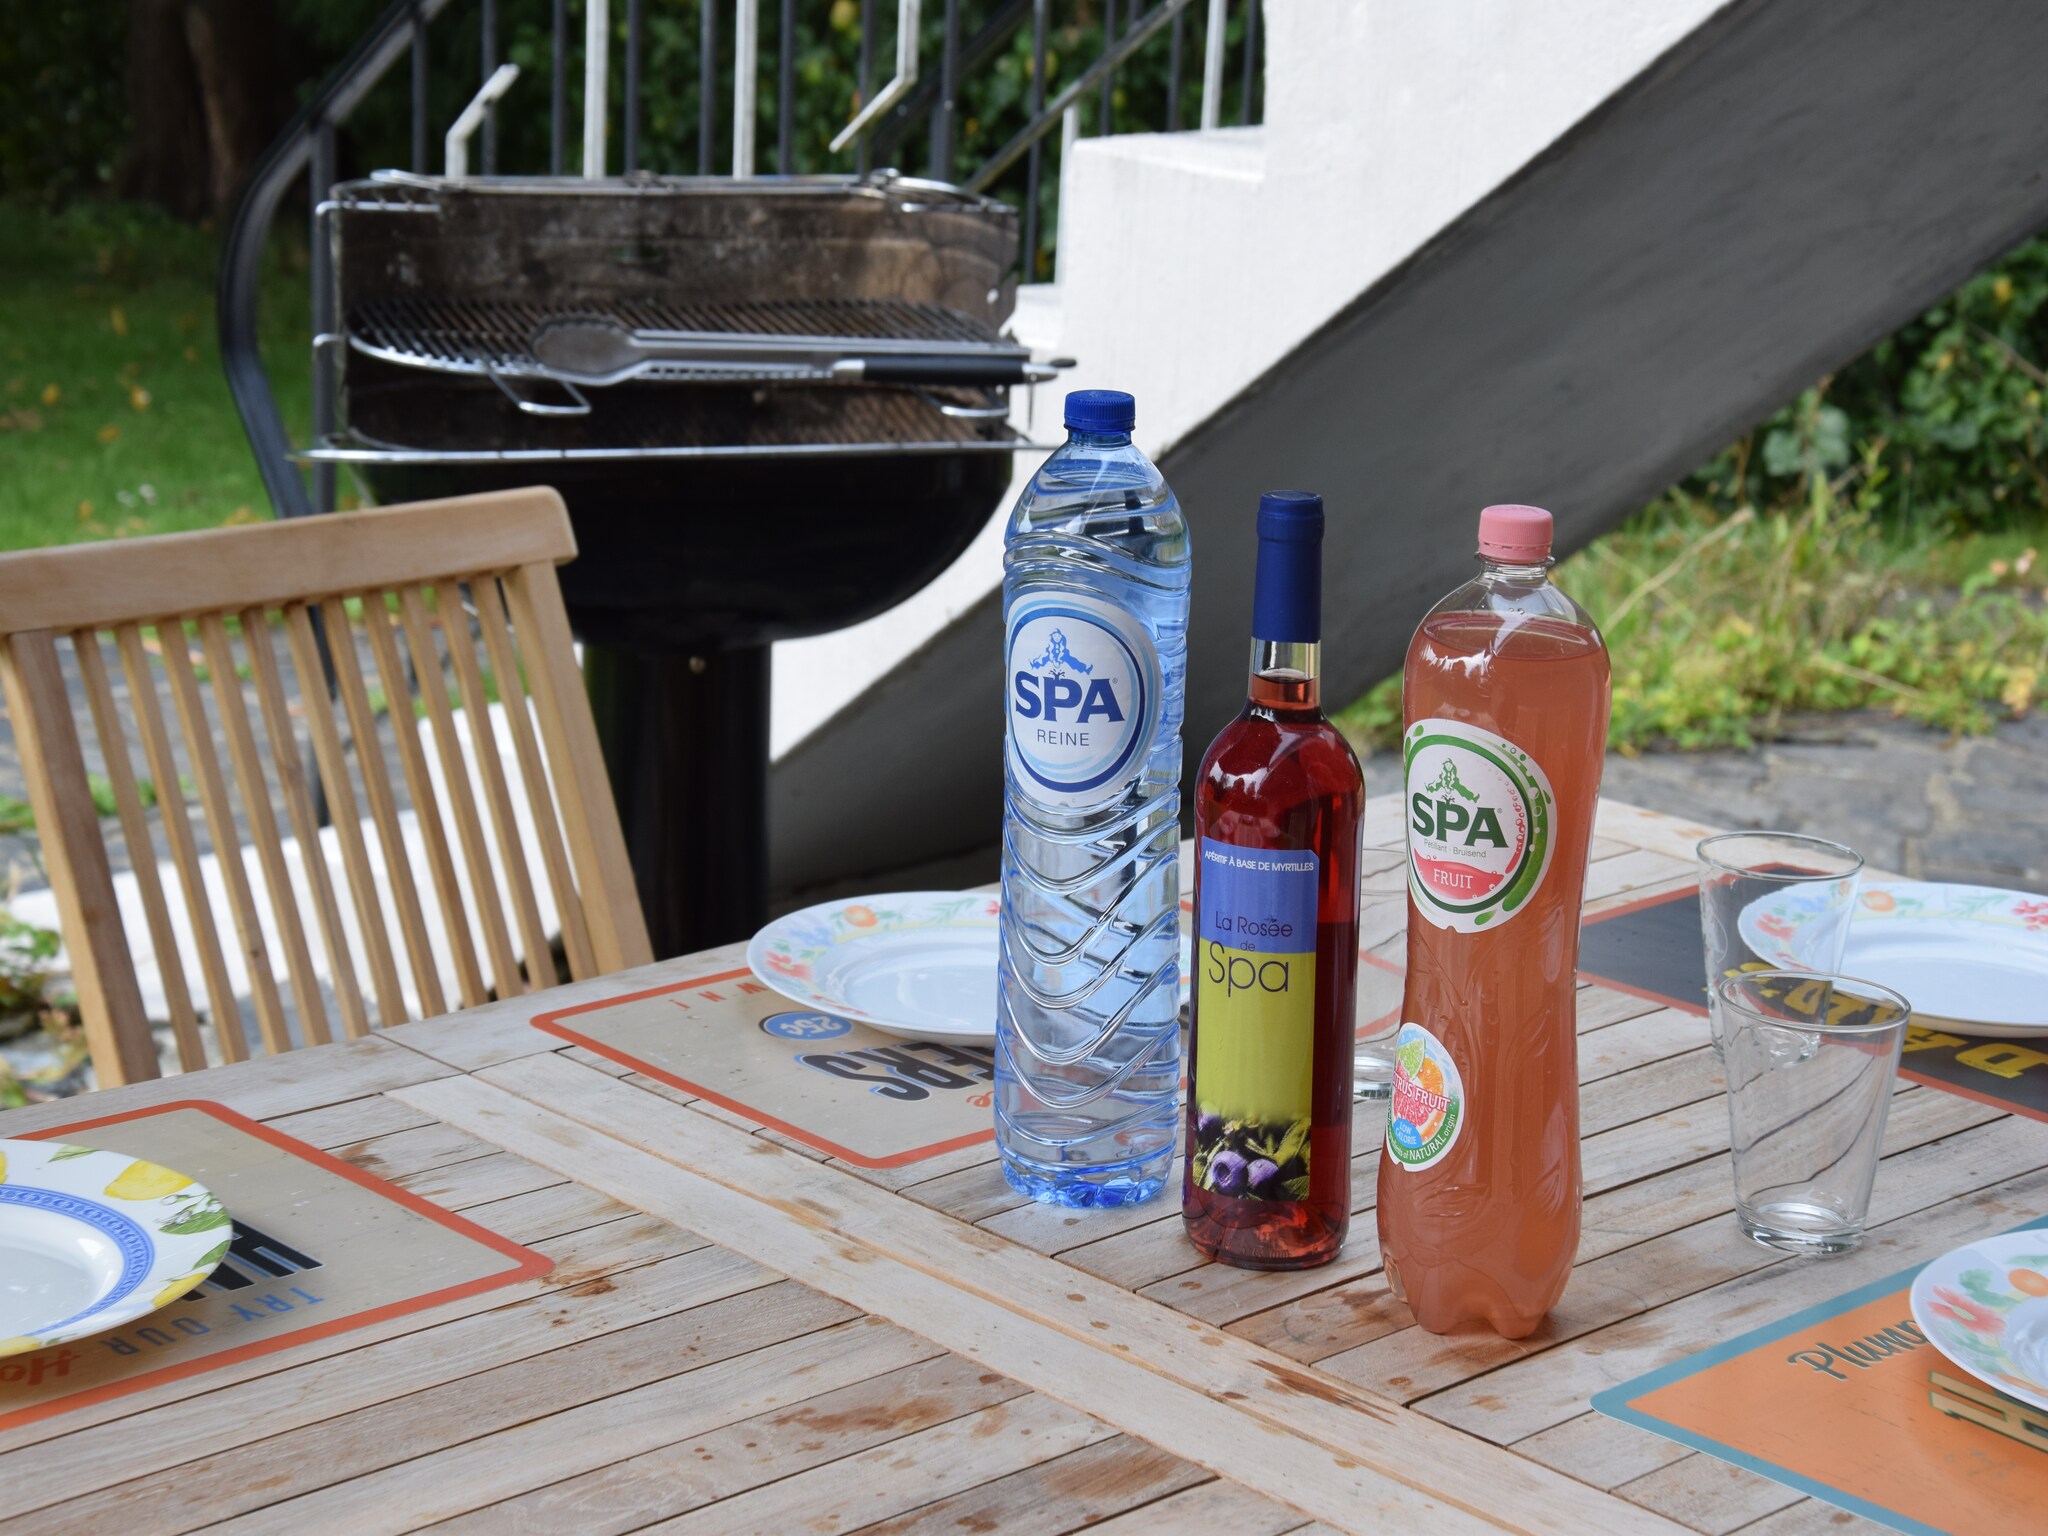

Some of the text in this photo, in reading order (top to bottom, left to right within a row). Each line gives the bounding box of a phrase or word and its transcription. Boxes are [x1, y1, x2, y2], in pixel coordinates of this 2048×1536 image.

[1015, 671, 1125, 723] SPA
[1037, 729, 1090, 746] REINE
[1412, 792, 1509, 848] SPA
[1204, 850, 1314, 872] APÉRITIF À BASE DE MYRTILLES
[1453, 847, 1487, 858] Bruisend
[1433, 868, 1474, 889] FRUIT
[1215, 911, 1293, 937] La Rosée
[1240, 940, 1256, 952] de
[1209, 941, 1289, 998] Spa
[1415, 1087, 1450, 1111] FRUIT
[1395, 1127, 1417, 1145] CALORIE
[1400, 1121, 1412, 1134] LOW
[1409, 1134, 1447, 1161] NATURAL
[1444, 1113, 1456, 1137] origin
[228, 1287, 325, 1321] TRY
[100, 1317, 211, 1356] OUR
